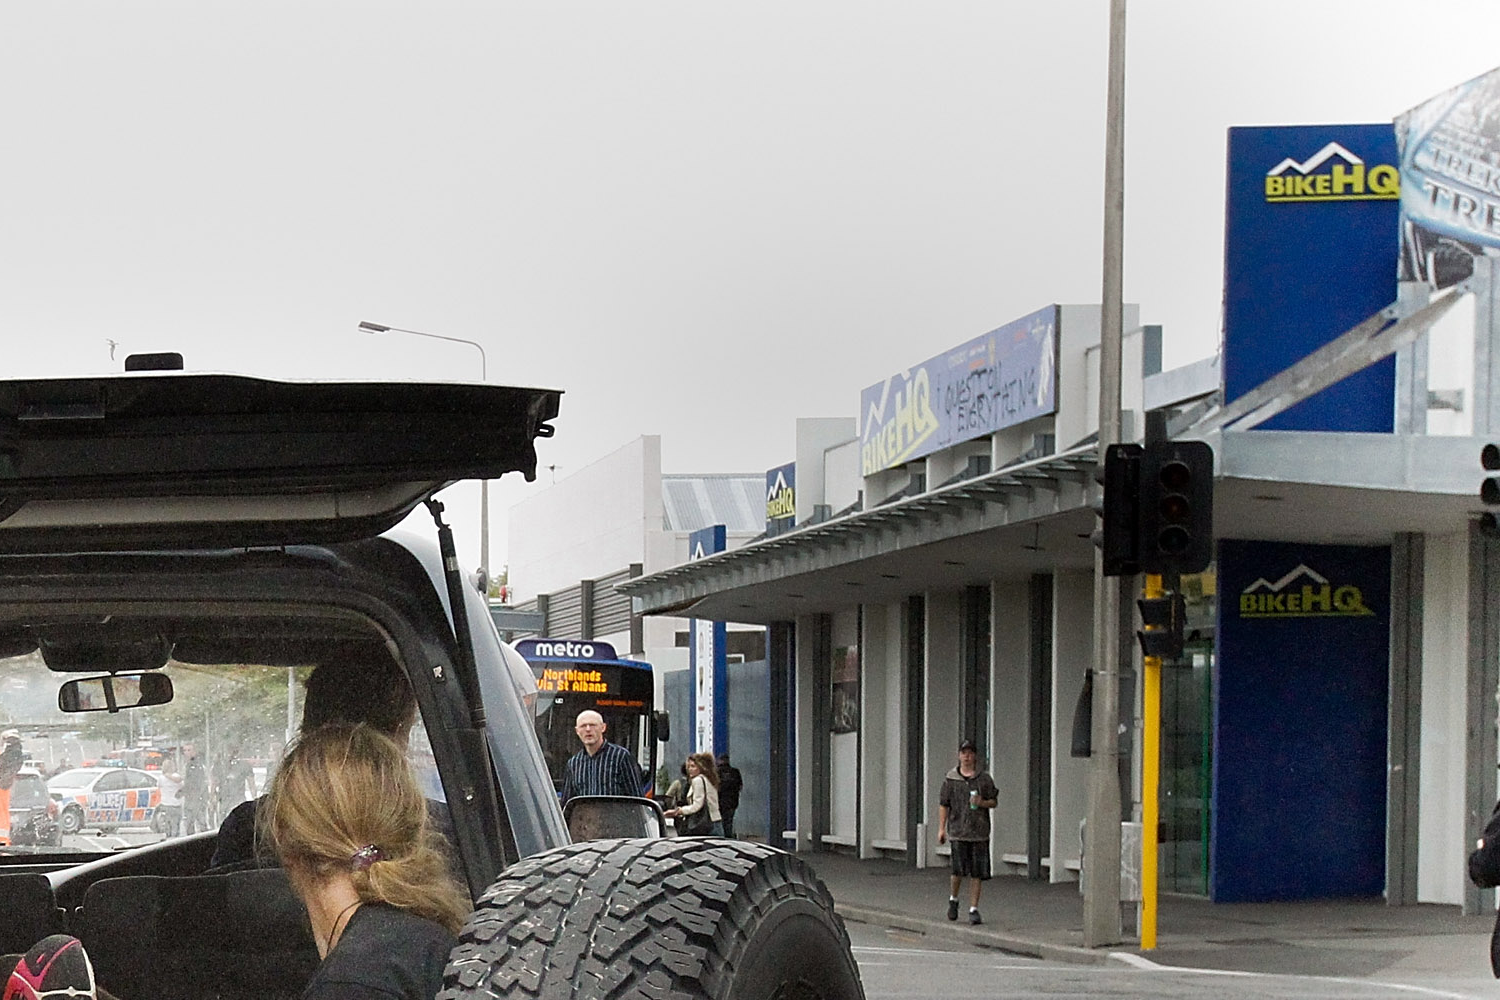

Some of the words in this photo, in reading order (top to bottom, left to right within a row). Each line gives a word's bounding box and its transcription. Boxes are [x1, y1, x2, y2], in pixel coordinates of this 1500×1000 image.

[1421, 180, 1500, 232] TRE
[535, 642, 595, 658] metro
[543, 669, 602, 682] Northlands
[556, 679, 569, 691] St
[572, 681, 608, 693] Albans
